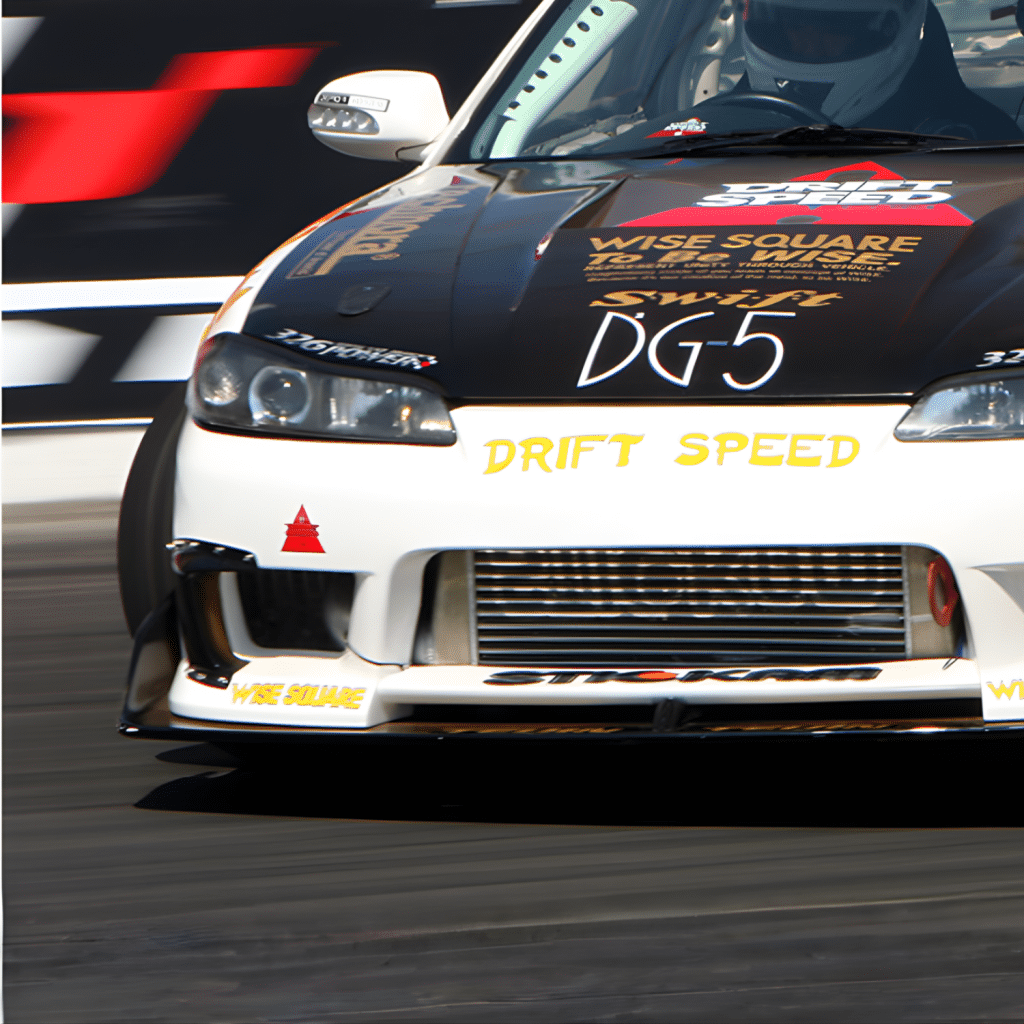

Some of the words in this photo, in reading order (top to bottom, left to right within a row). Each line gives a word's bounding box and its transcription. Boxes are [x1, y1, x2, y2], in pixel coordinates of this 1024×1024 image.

[697, 191, 953, 208] SPEED
[588, 234, 717, 252] WISE
[720, 233, 923, 253] SQUARE
[482, 433, 646, 475] DRIFT
[674, 432, 861, 469] SPEED
[230, 682, 285, 707] WISE
[283, 683, 367, 711] SQUARE
